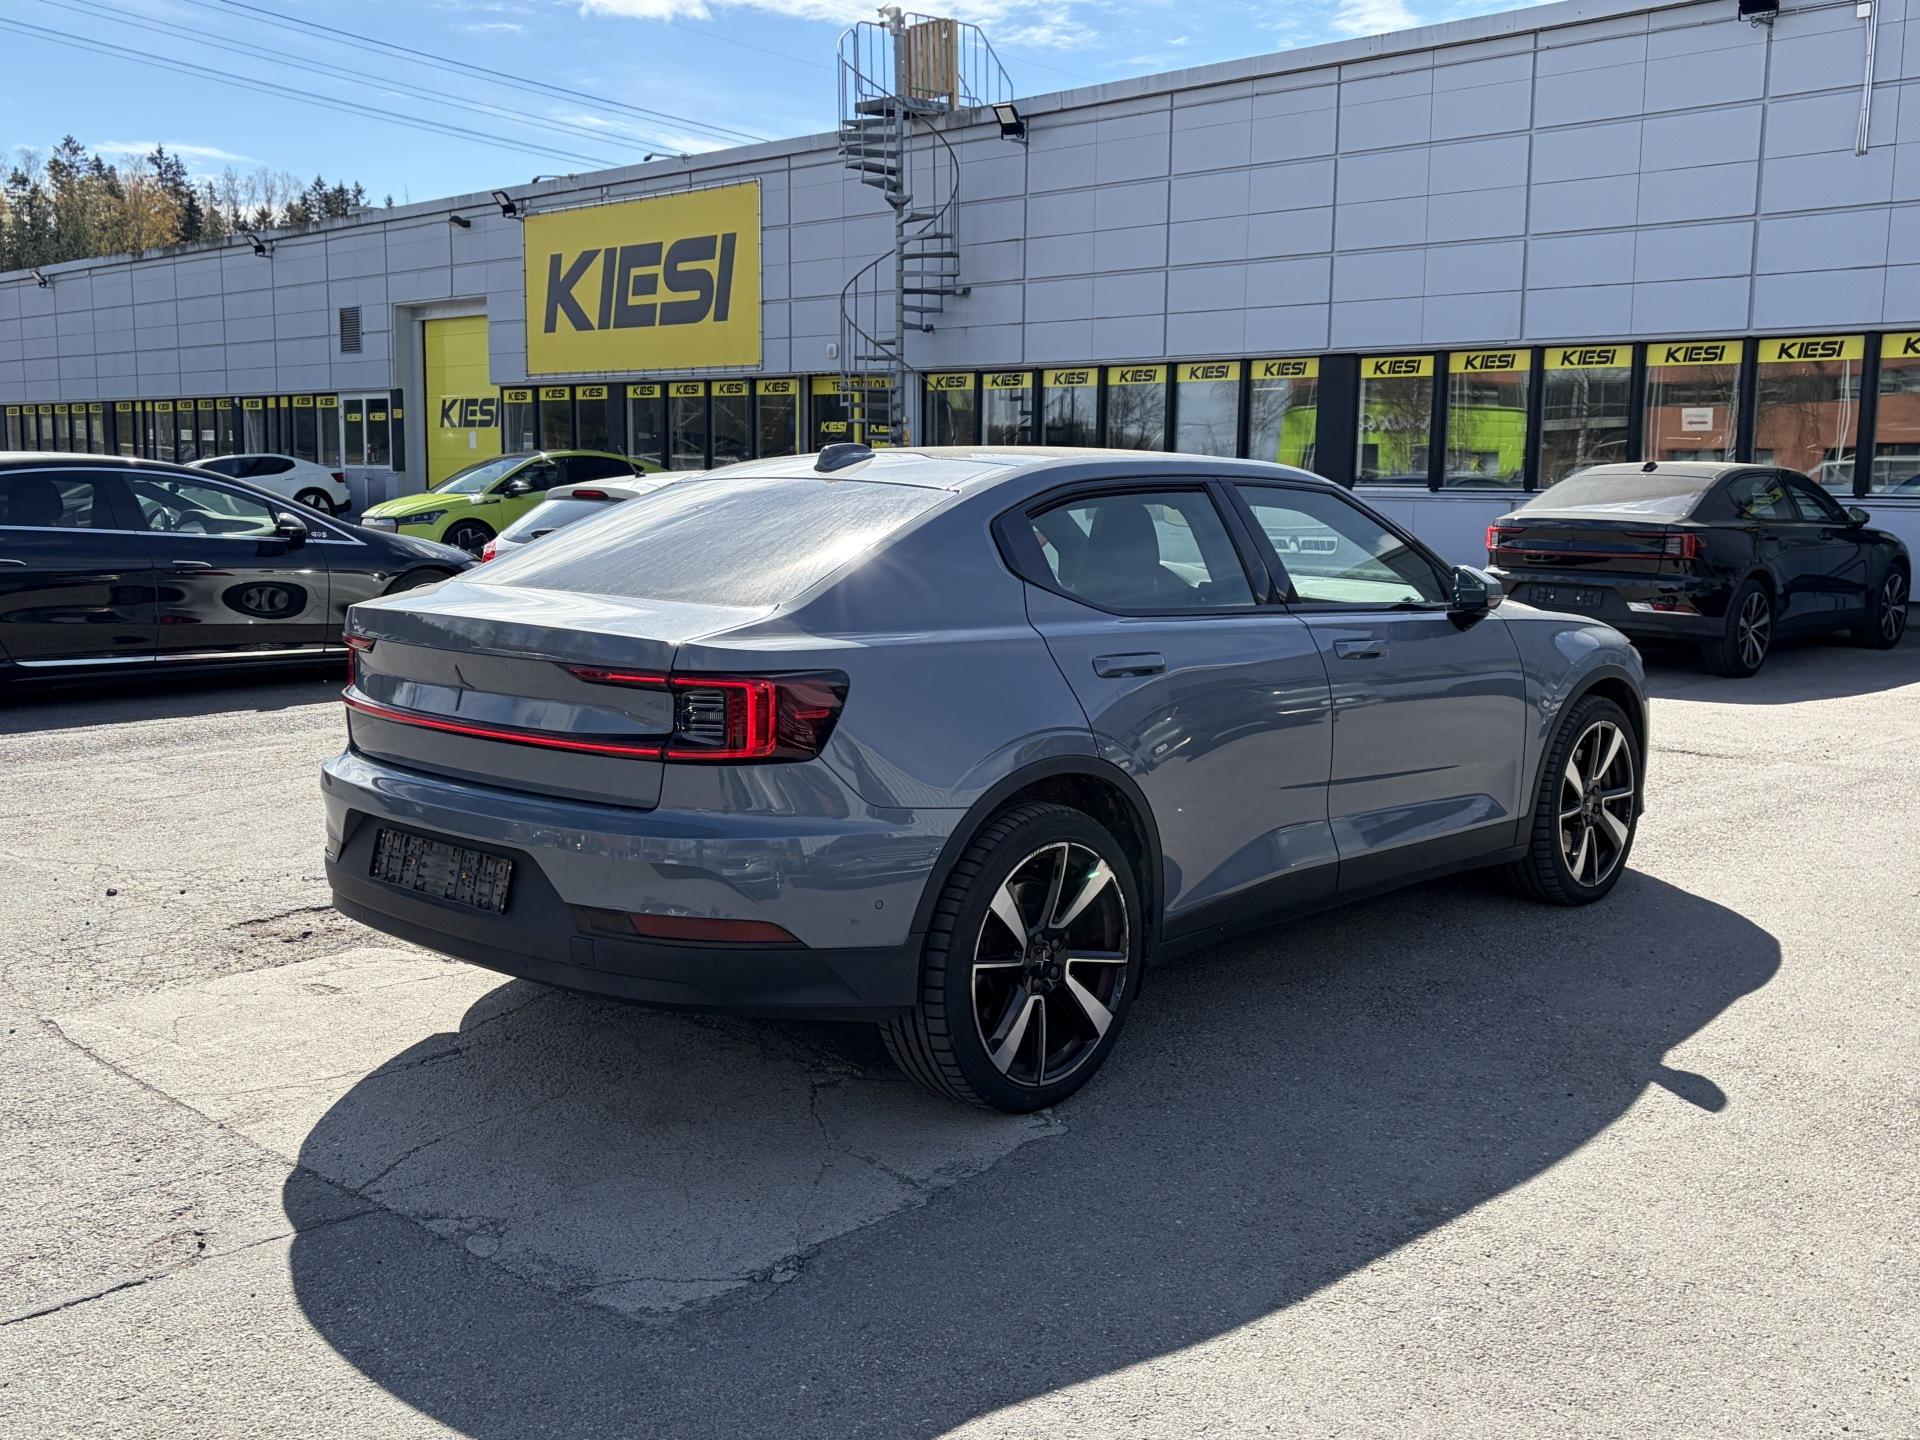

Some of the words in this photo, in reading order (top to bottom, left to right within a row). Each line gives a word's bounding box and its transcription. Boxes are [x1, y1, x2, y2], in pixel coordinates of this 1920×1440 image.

[544, 232, 736, 333] KIESI
[1665, 345, 1725, 363] KIESI
[1777, 340, 1845, 360] KIESI
[1464, 353, 1516, 369] KIESI
[1560, 349, 1617, 366] KIESI
[1190, 365, 1230, 379] KIESI
[1264, 362, 1307, 377] KIESI
[1374, 359, 1421, 375] KIESI
[936, 376, 967, 389] KIESI
[991, 374, 1024, 387] KIESI
[1054, 372, 1089, 385] KIESI
[1119, 369, 1157, 384] KIESI
[546, 389, 565, 398] KIESI
[583, 388, 603, 397] KIESI
[633, 386, 655, 395] KIESI
[676, 384, 699, 394] KIESI
[719, 383, 743, 393] KIESI
[764, 382, 790, 393] KIESI
[509, 392, 527, 400] KIESI
[440, 398, 499, 428] KIESI
[821, 422, 848, 433] KIESI
[870, 424, 897, 433] KIE
